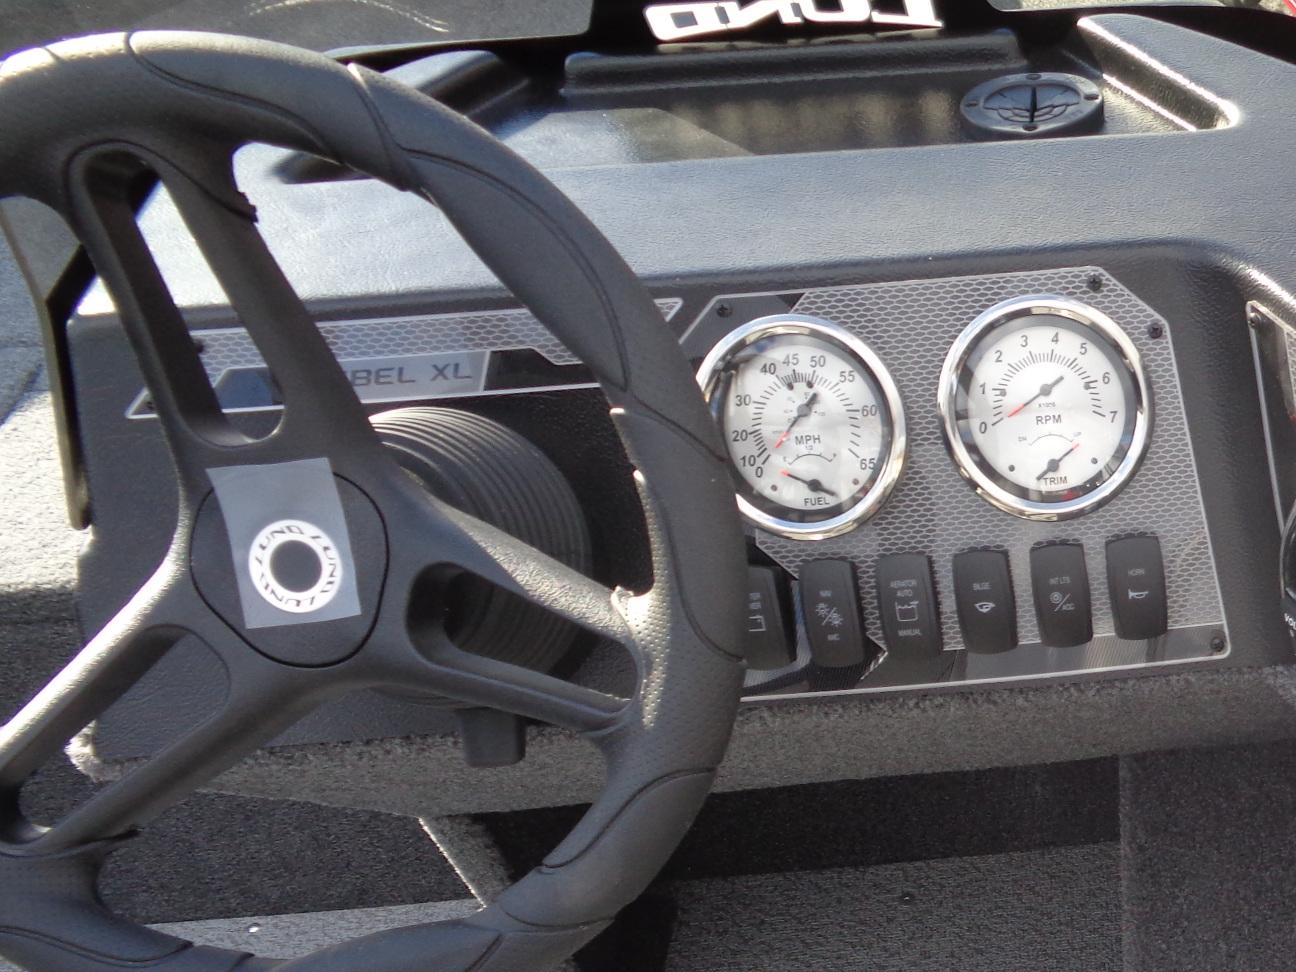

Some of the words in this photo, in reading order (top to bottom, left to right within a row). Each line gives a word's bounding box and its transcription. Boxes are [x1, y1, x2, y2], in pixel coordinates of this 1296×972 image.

[1020, 335, 1029, 347] 3
[1050, 332, 1060, 344] 4
[1079, 342, 1088, 355] 5
[782, 353, 799, 367] 45
[809, 355, 826, 368] 50
[995, 350, 1003, 363] 2
[430, 362, 472, 381] XL
[760, 362, 777, 376] 40
[839, 370, 856, 383] 55
[1102, 372, 1111, 385] 6
[979, 383, 986, 394] 1
[735, 395, 752, 407] 30
[861, 404, 877, 417] 60
[1035, 415, 1062, 425] RPM
[1109, 411, 1117, 424] 7
[979, 422, 988, 434] 0
[732, 429, 749, 442] 20
[795, 434, 821, 445] MPH
[740, 454, 757, 468] 10
[860, 457, 876, 471] 65
[755, 466, 763, 478] 0
[1043, 476, 1068, 486] TRIM
[803, 497, 830, 506] FUEL
